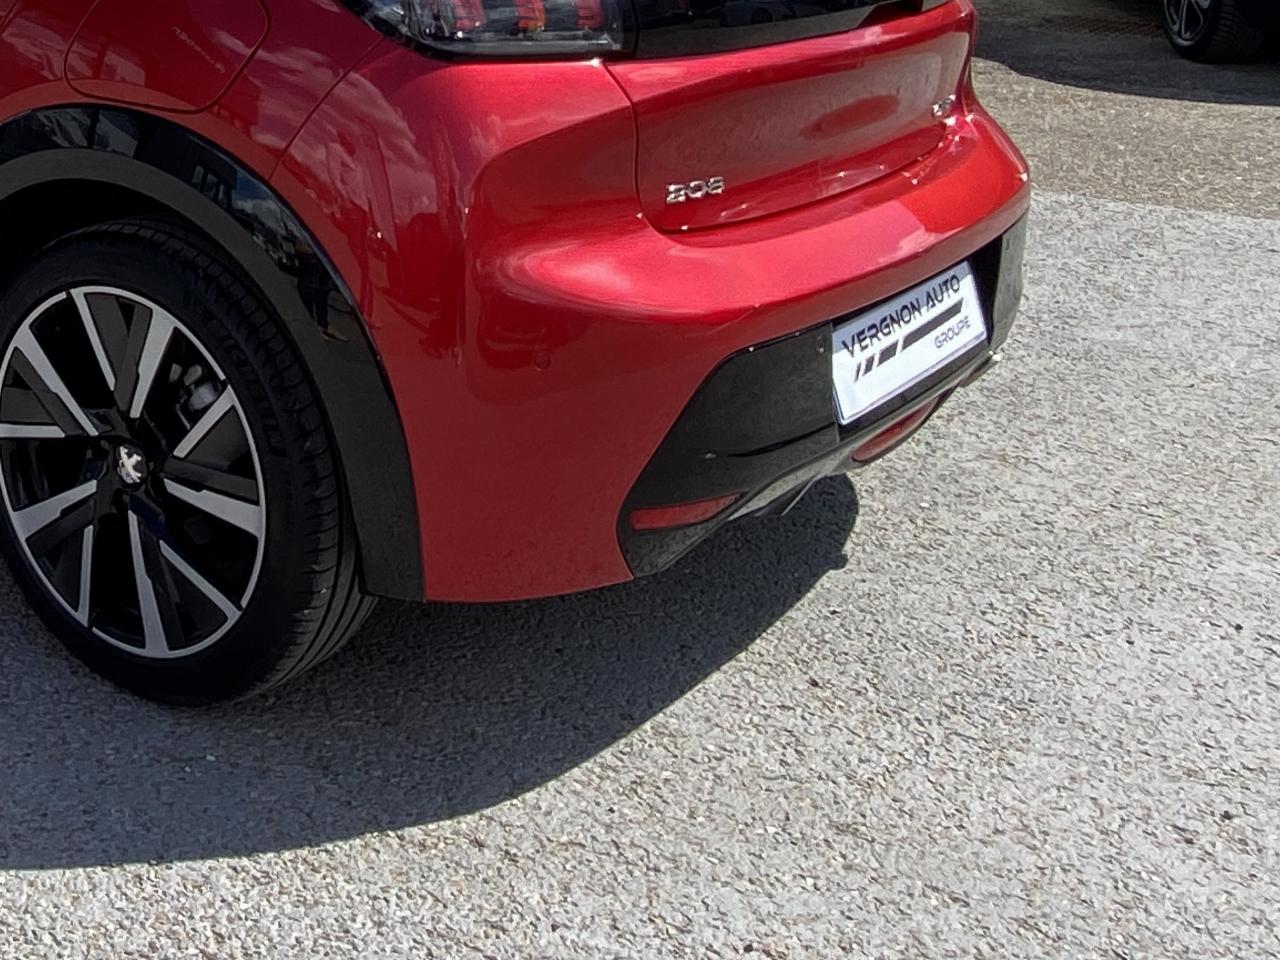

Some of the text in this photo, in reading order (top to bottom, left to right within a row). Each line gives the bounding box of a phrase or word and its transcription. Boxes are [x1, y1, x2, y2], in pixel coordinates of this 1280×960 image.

[841, 274, 961, 358] VERGNON AUTO
[934, 316, 971, 350] GROUPE
